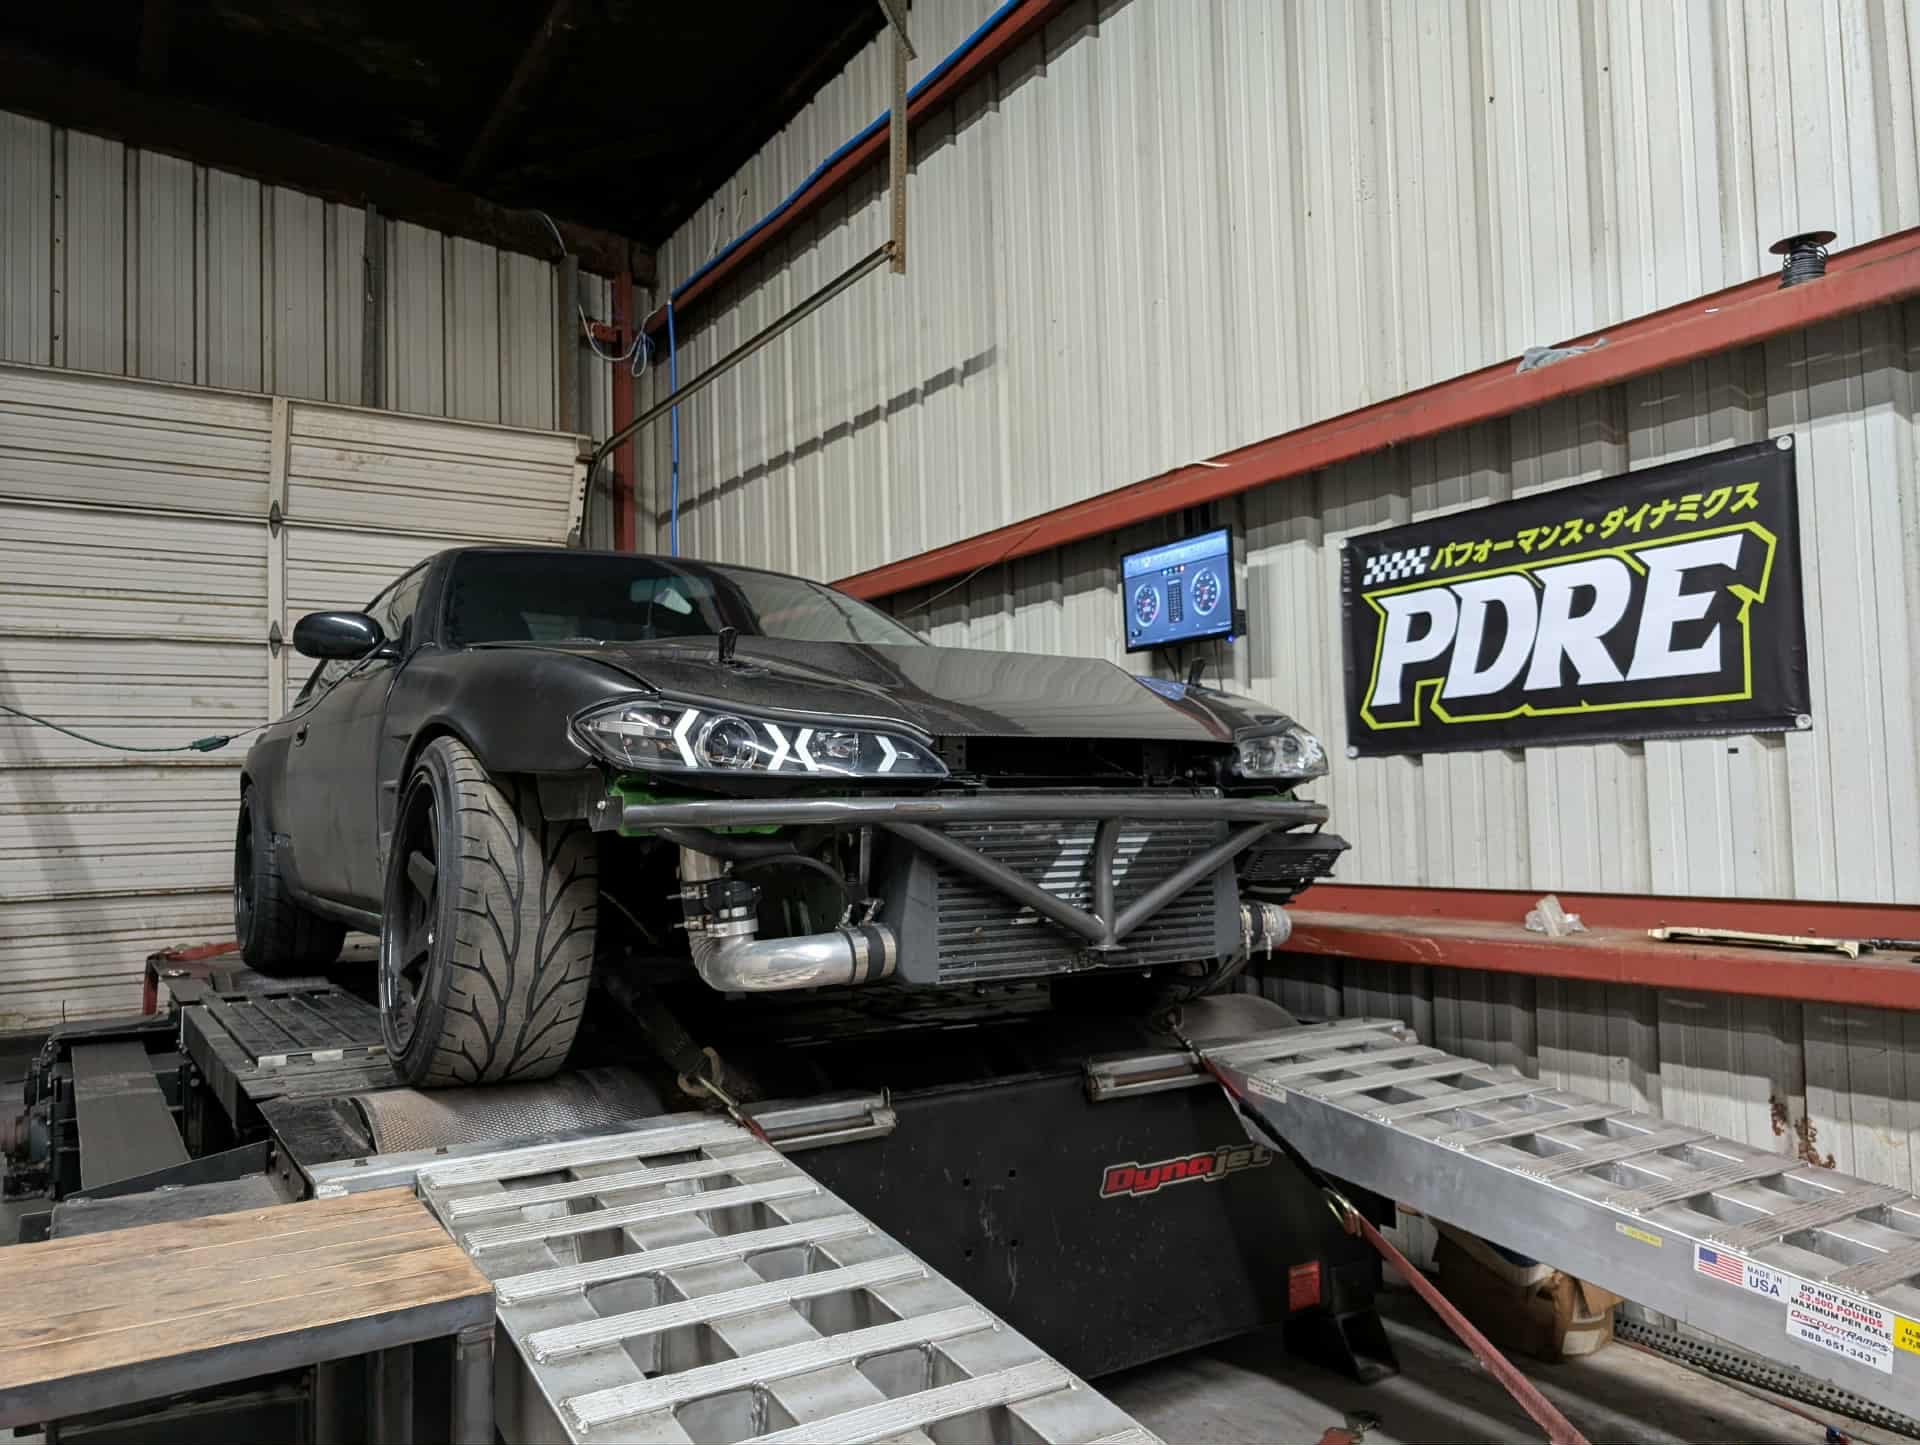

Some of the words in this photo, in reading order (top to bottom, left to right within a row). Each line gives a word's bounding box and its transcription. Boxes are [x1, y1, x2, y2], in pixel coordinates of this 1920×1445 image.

[1431, 481, 1760, 571] パフォーマンス・ダイナミクス
[1371, 533, 1744, 707] PDRE
[1747, 1266, 1770, 1280] MADE
[1773, 1272, 1783, 1285] IN
[1749, 1275, 1780, 1297] USA
[1791, 1297, 1839, 1320] MAXIMUM
[1841, 1317, 1862, 1329] PER
[1864, 1325, 1892, 1341] AXLE
[1801, 1284, 1815, 1294] DO
[1818, 1291, 1838, 1303] NOT
[1841, 1299, 1882, 1319] EXCEED
[1836, 1304, 1884, 1328] POUNDS
[1800, 1329, 1878, 1364] 888-651-3431
